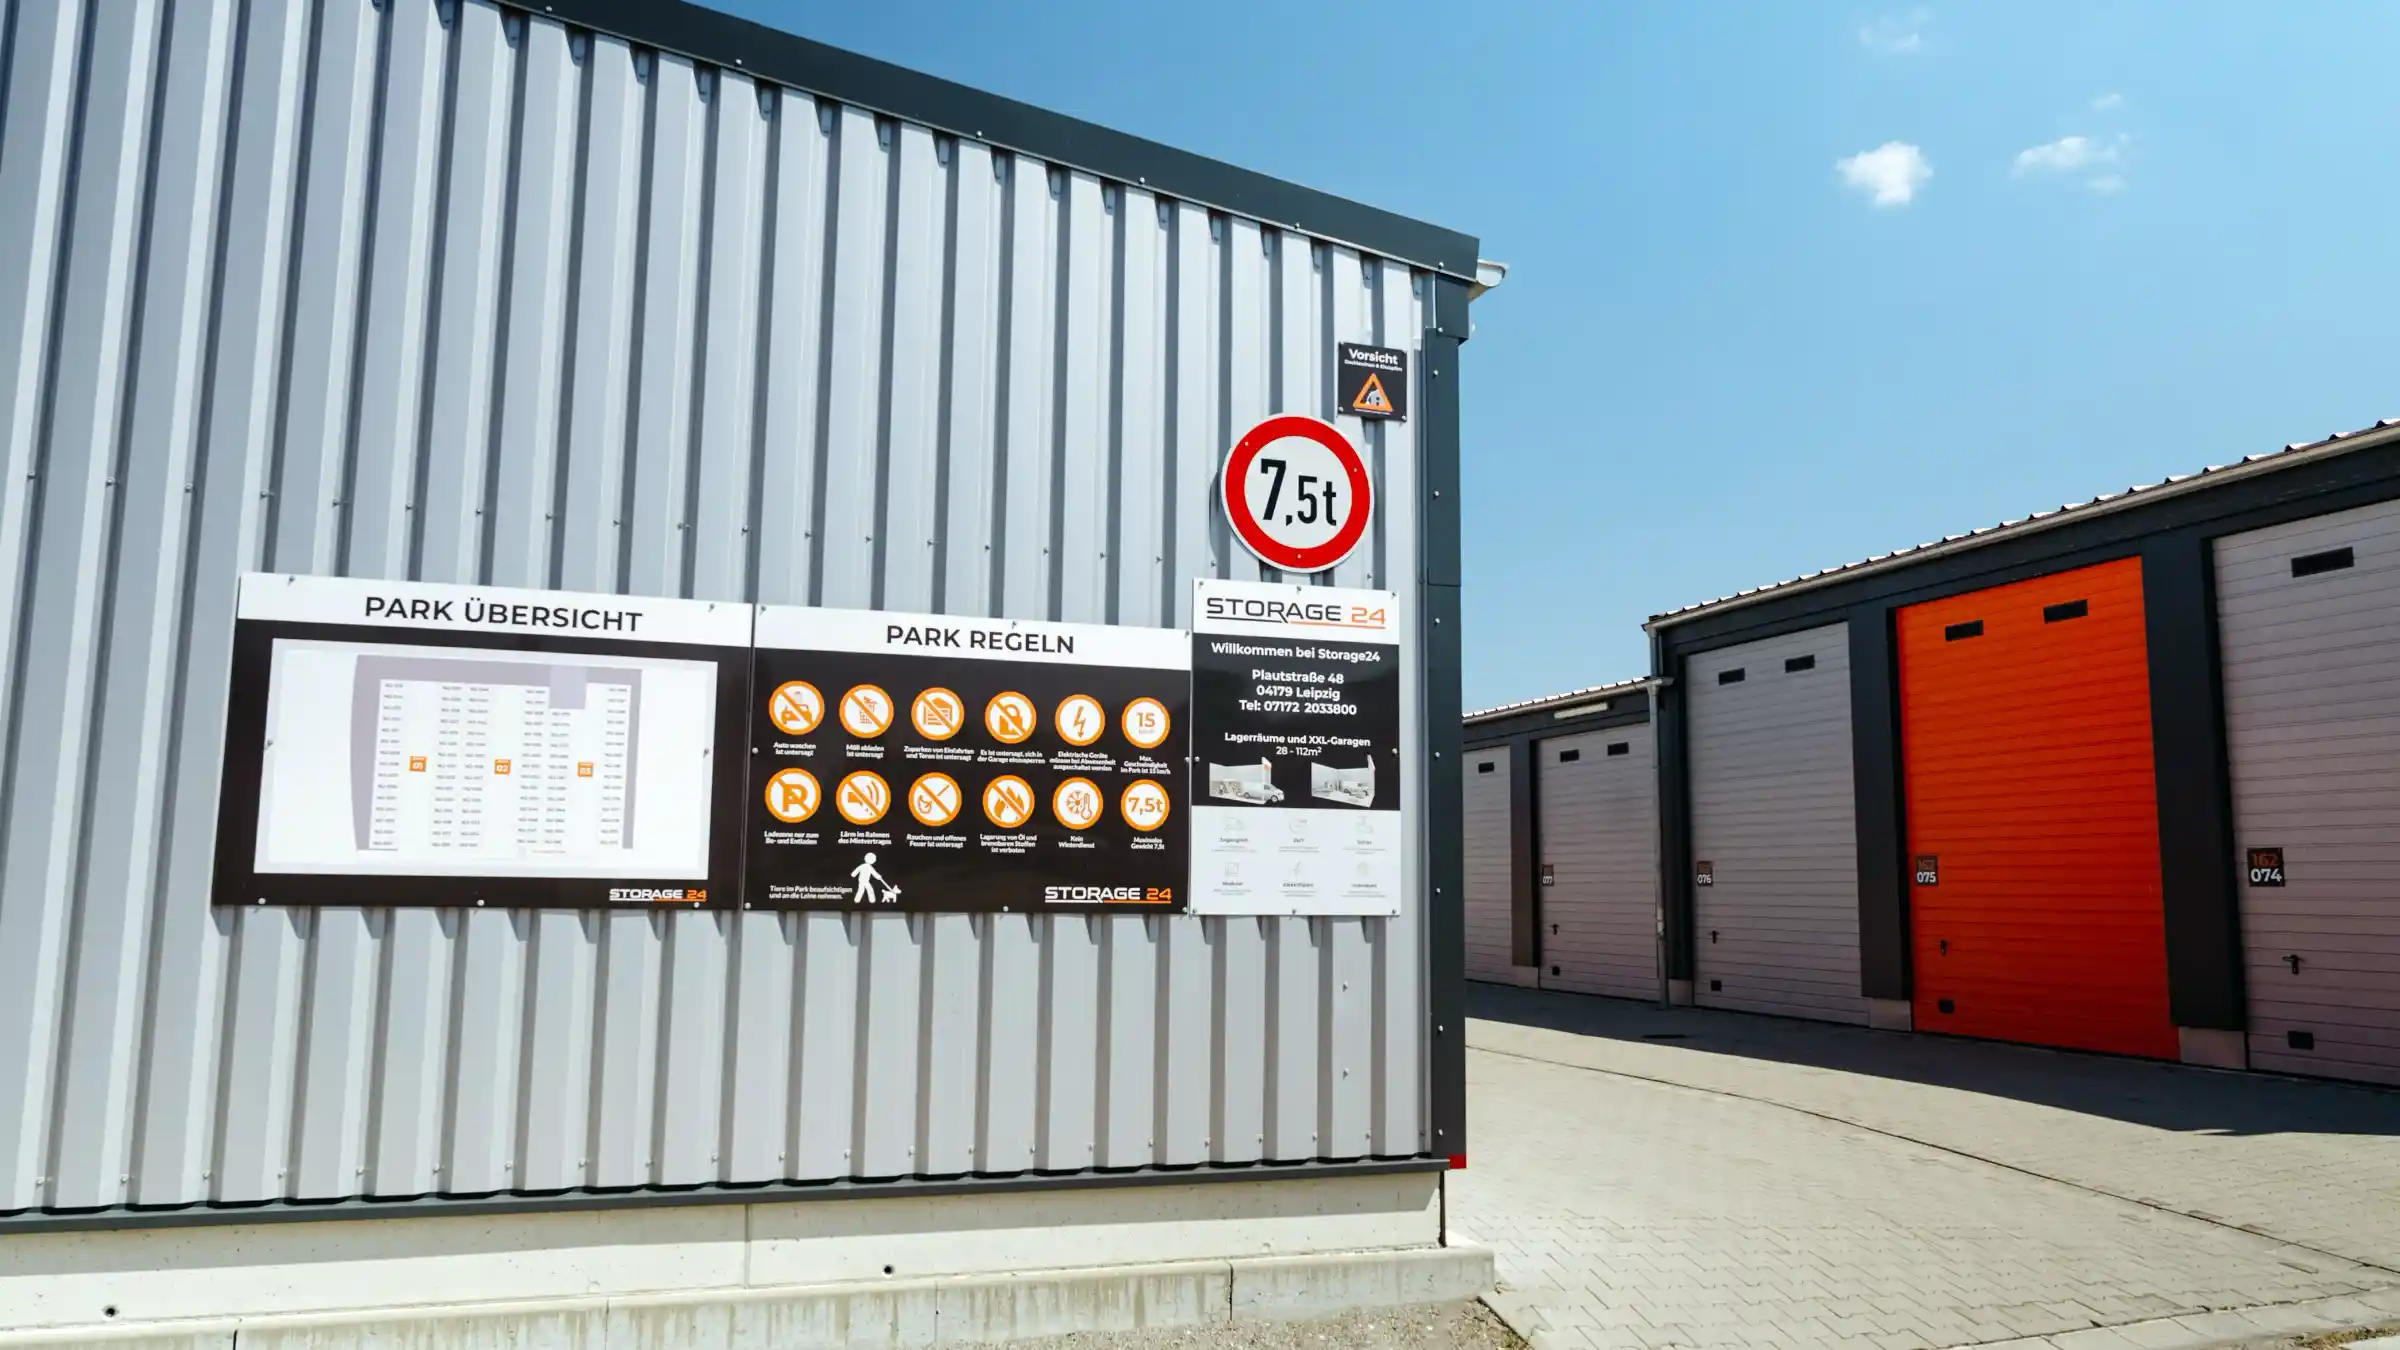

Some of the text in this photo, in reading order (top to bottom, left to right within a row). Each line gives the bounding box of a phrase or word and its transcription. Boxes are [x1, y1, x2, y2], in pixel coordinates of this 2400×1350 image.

[1348, 348, 1398, 364] Vorsicht
[1260, 458, 1336, 526] 7,5t
[365, 596, 643, 632] PARK ÜBERSICHT
[1206, 598, 1386, 624] STORAGE 24
[886, 624, 1074, 654] PARK REGELN
[1211, 642, 1380, 663] Willkommen bei Storage24
[1252, 669, 1344, 684] Plautstraße 48
[1256, 685, 1340, 701] 04179 Leipzig
[1239, 700, 1357, 715] Tel: 07172 2033800
[1136, 712, 1155, 728] 15
[1225, 732, 1370, 747] Lagerräume und XXL-Garagen
[904, 746, 932, 754] Zuparken
[1276, 746, 1288, 755] 28
[1124, 761, 1167, 770] Geschwindigkeit
[1128, 796, 1163, 816] 7,5t
[1697, 874, 1711, 884] 076
[1916, 872, 1936, 883] 075
[2250, 868, 2282, 882] 074
[609, 888, 707, 900] STORAGE 24
[1044, 886, 1172, 902] STORAGE 24
